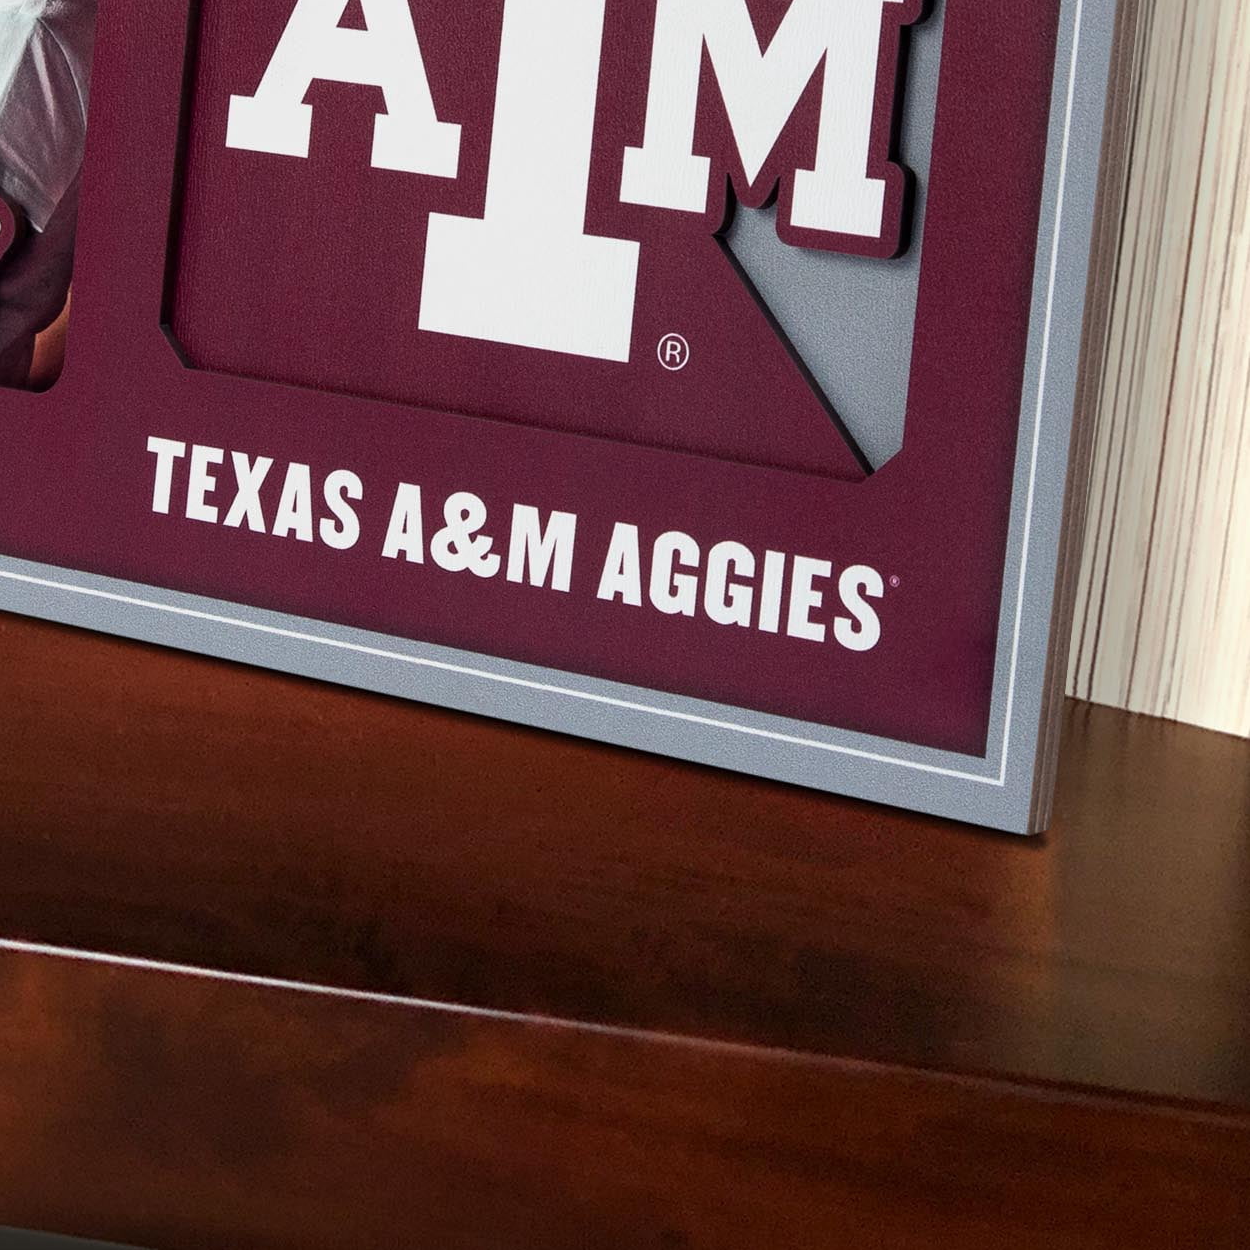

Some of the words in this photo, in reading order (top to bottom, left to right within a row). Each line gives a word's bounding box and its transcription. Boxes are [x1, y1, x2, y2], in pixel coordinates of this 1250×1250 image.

[147, 435, 363, 550] TEXAS
[381, 482, 577, 593] A&M
[596, 521, 884, 652] AGGIES
